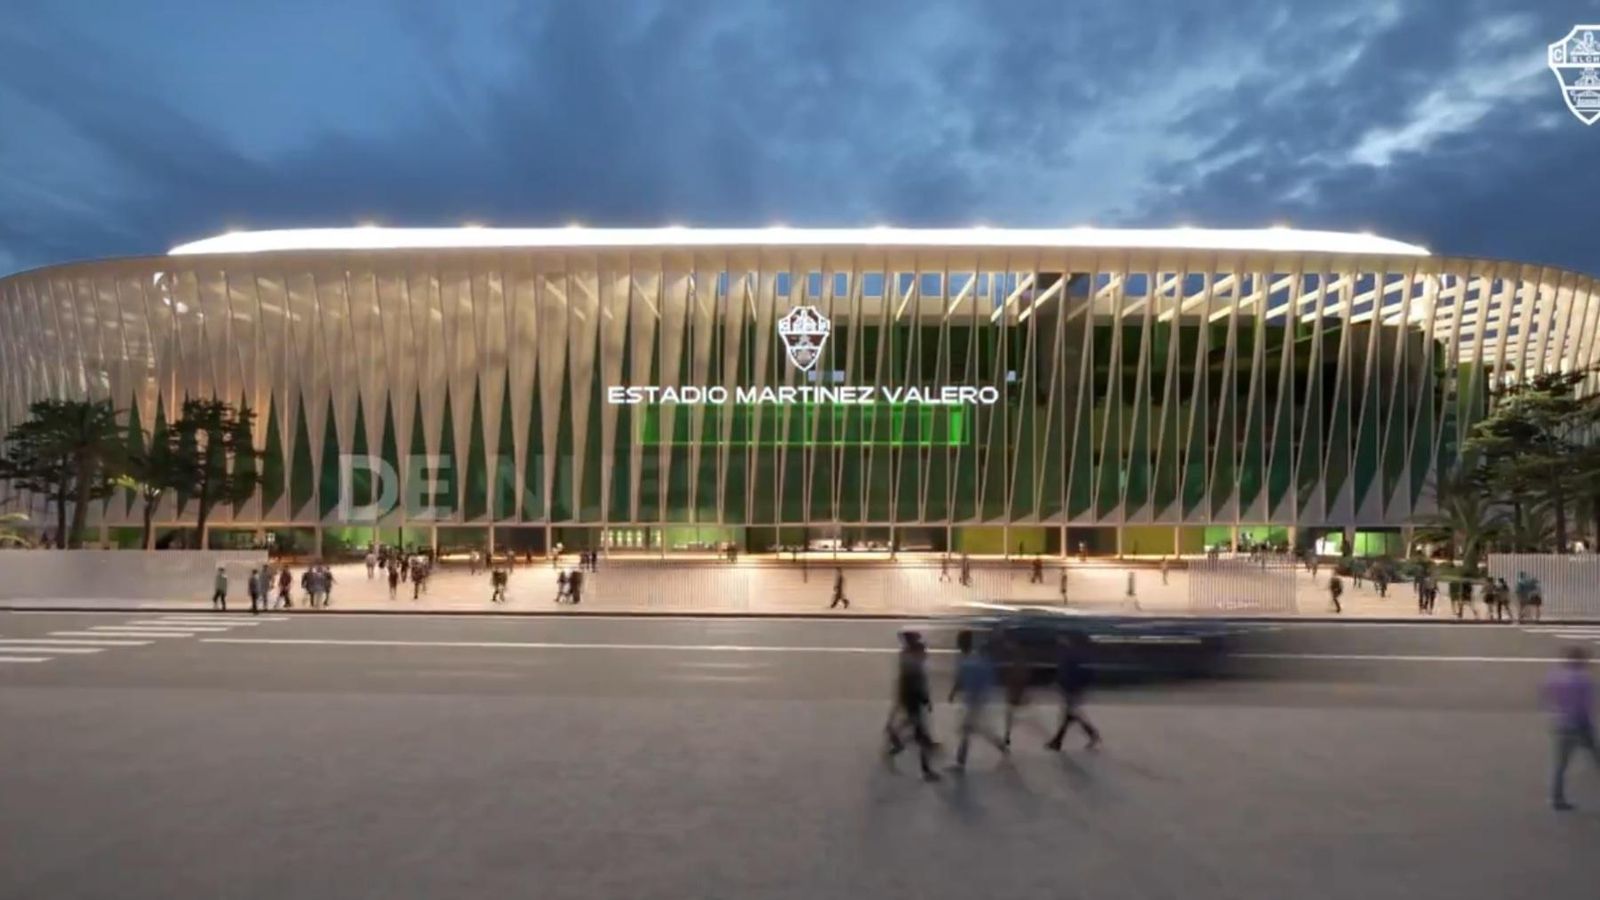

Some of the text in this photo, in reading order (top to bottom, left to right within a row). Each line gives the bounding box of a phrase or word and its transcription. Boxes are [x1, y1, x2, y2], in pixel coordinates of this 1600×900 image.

[607, 386, 999, 404] ESTADIO MARTINEZ VALERO
